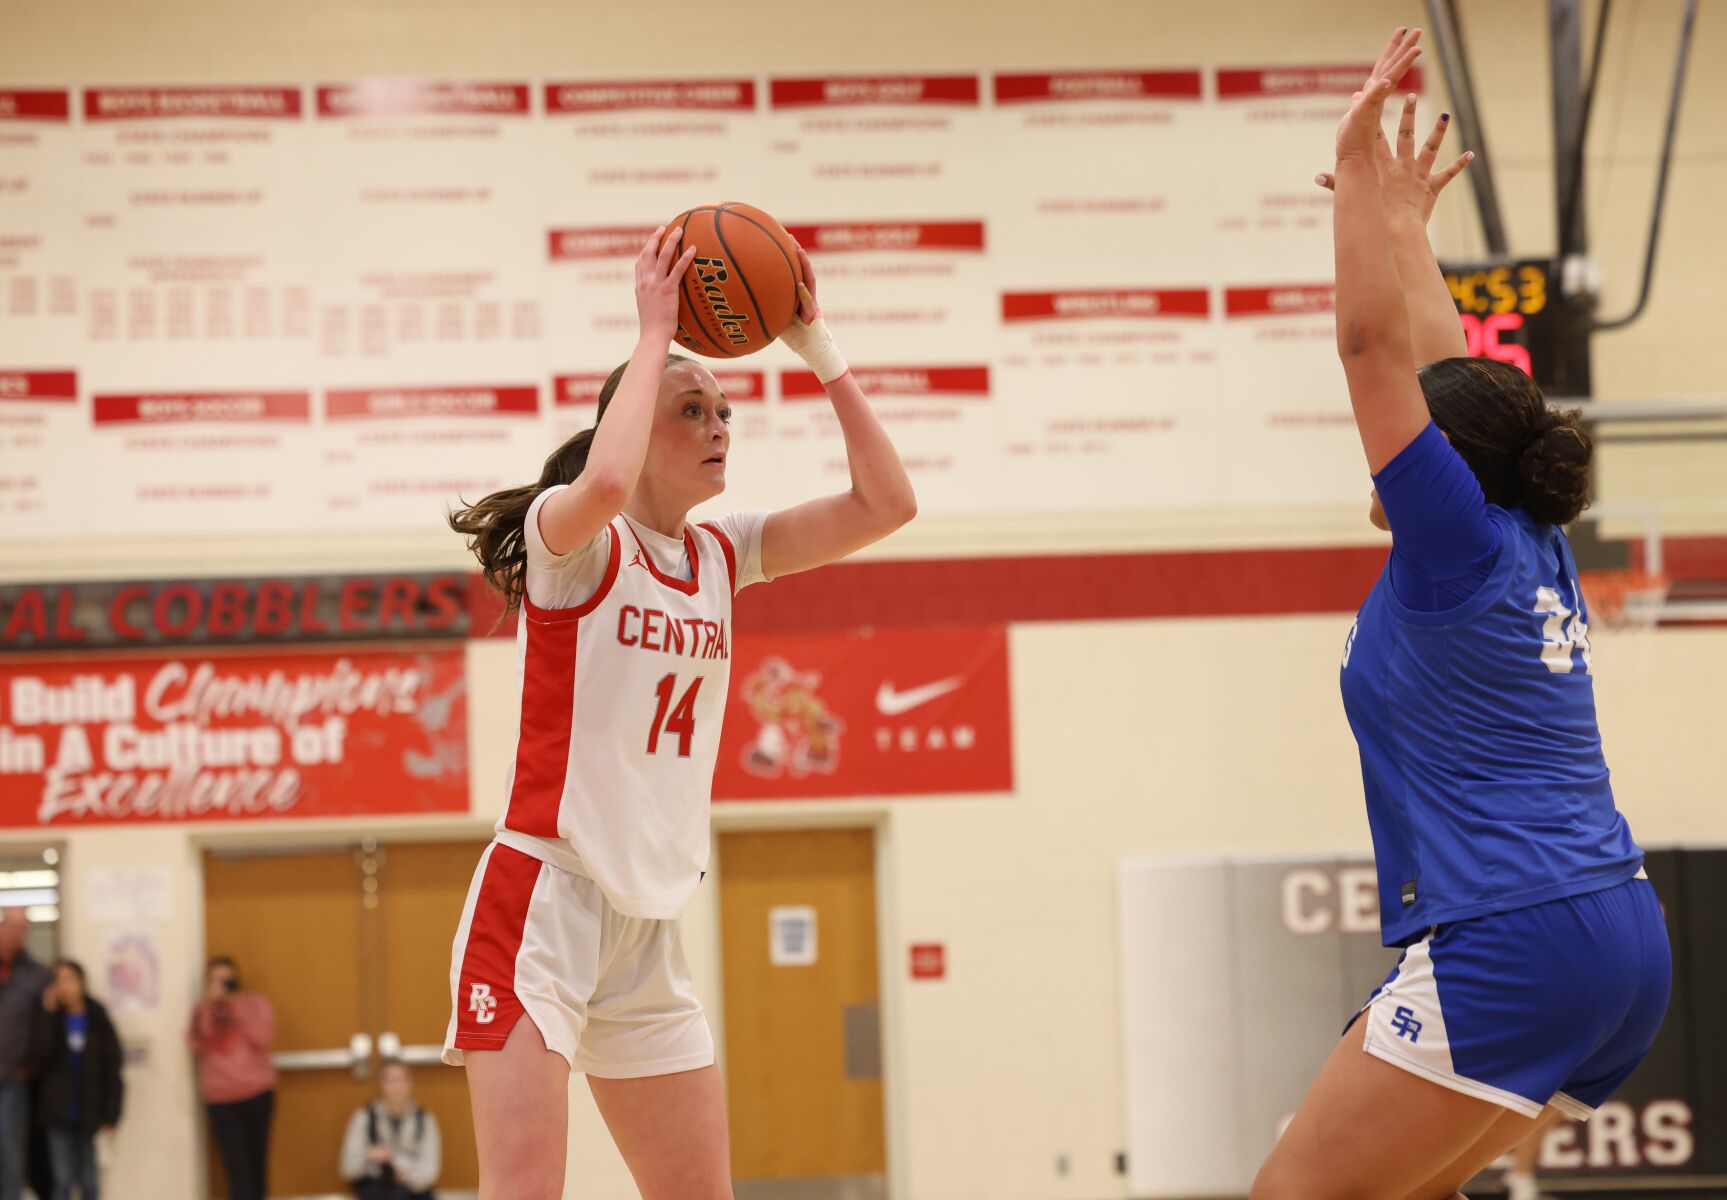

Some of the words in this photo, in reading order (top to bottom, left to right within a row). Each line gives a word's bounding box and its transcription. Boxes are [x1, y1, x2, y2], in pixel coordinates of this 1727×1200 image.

[694, 257, 750, 345] Baden
[107, 575, 463, 640] COBBLERS
[617, 604, 729, 660] CENTRAL
[11, 673, 134, 726] Build
[145, 658, 422, 729] Champions
[646, 672, 704, 758] 14
[57, 725, 92, 772] A
[104, 721, 281, 771] Culture
[291, 716, 346, 765] of
[875, 727, 976, 752] TEAM
[38, 767, 301, 823] Excellence
[468, 982, 497, 1025] RC
[1391, 1005, 1423, 1043] SR
[1492, 1098, 1695, 1169] ERS
